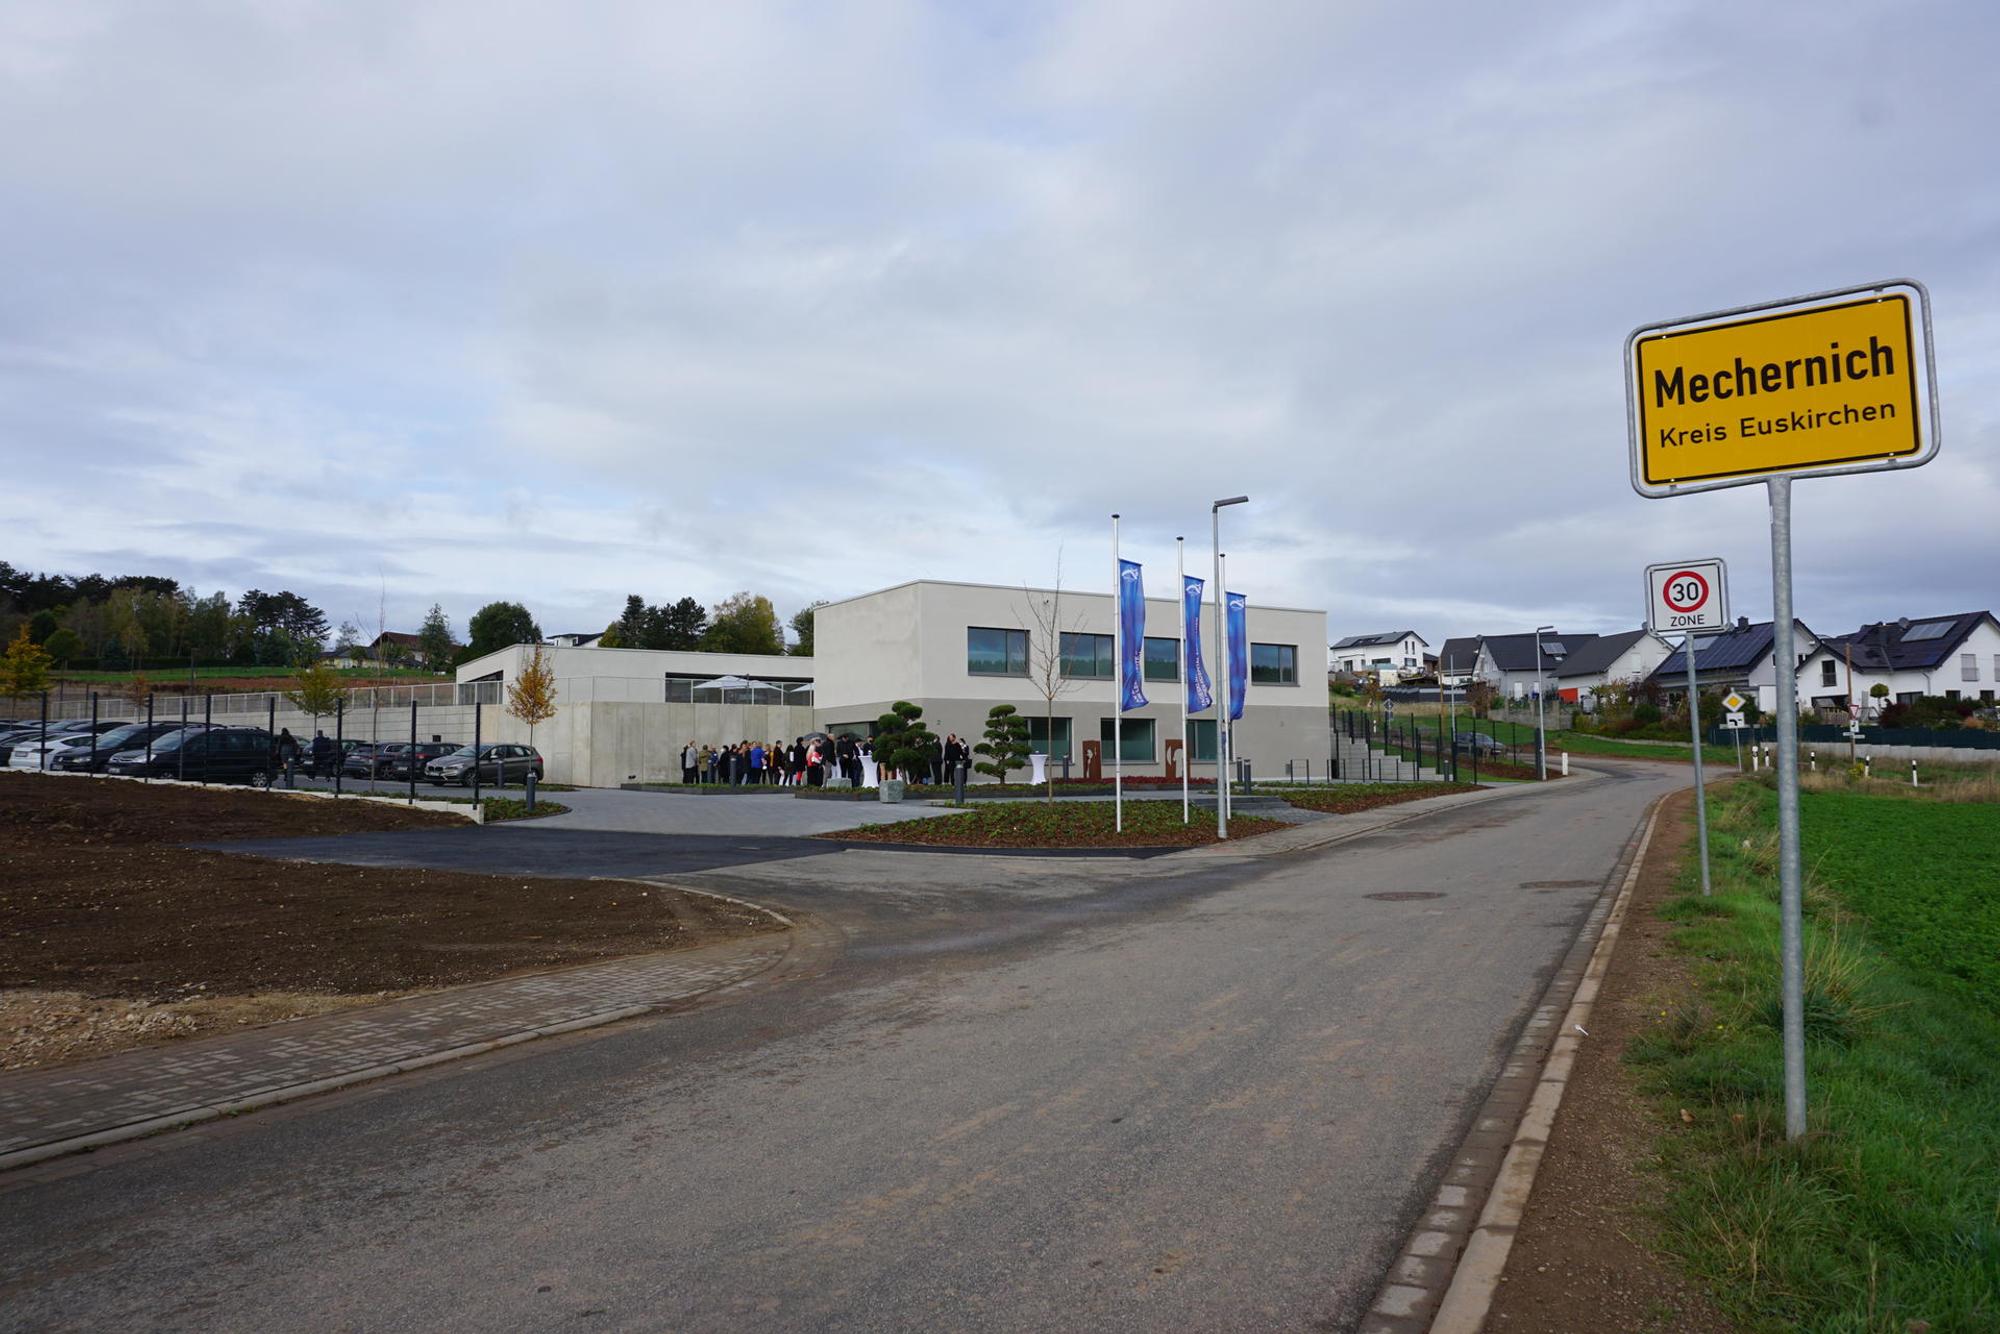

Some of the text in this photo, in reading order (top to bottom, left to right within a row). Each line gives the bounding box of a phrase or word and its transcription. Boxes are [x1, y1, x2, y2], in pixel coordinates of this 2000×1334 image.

[1654, 336, 1895, 408] Mechernich
[1660, 402, 1896, 448] Kreis Euskirchen
[1672, 581, 1699, 602] 30
[1670, 614, 1705, 627] ZONE
